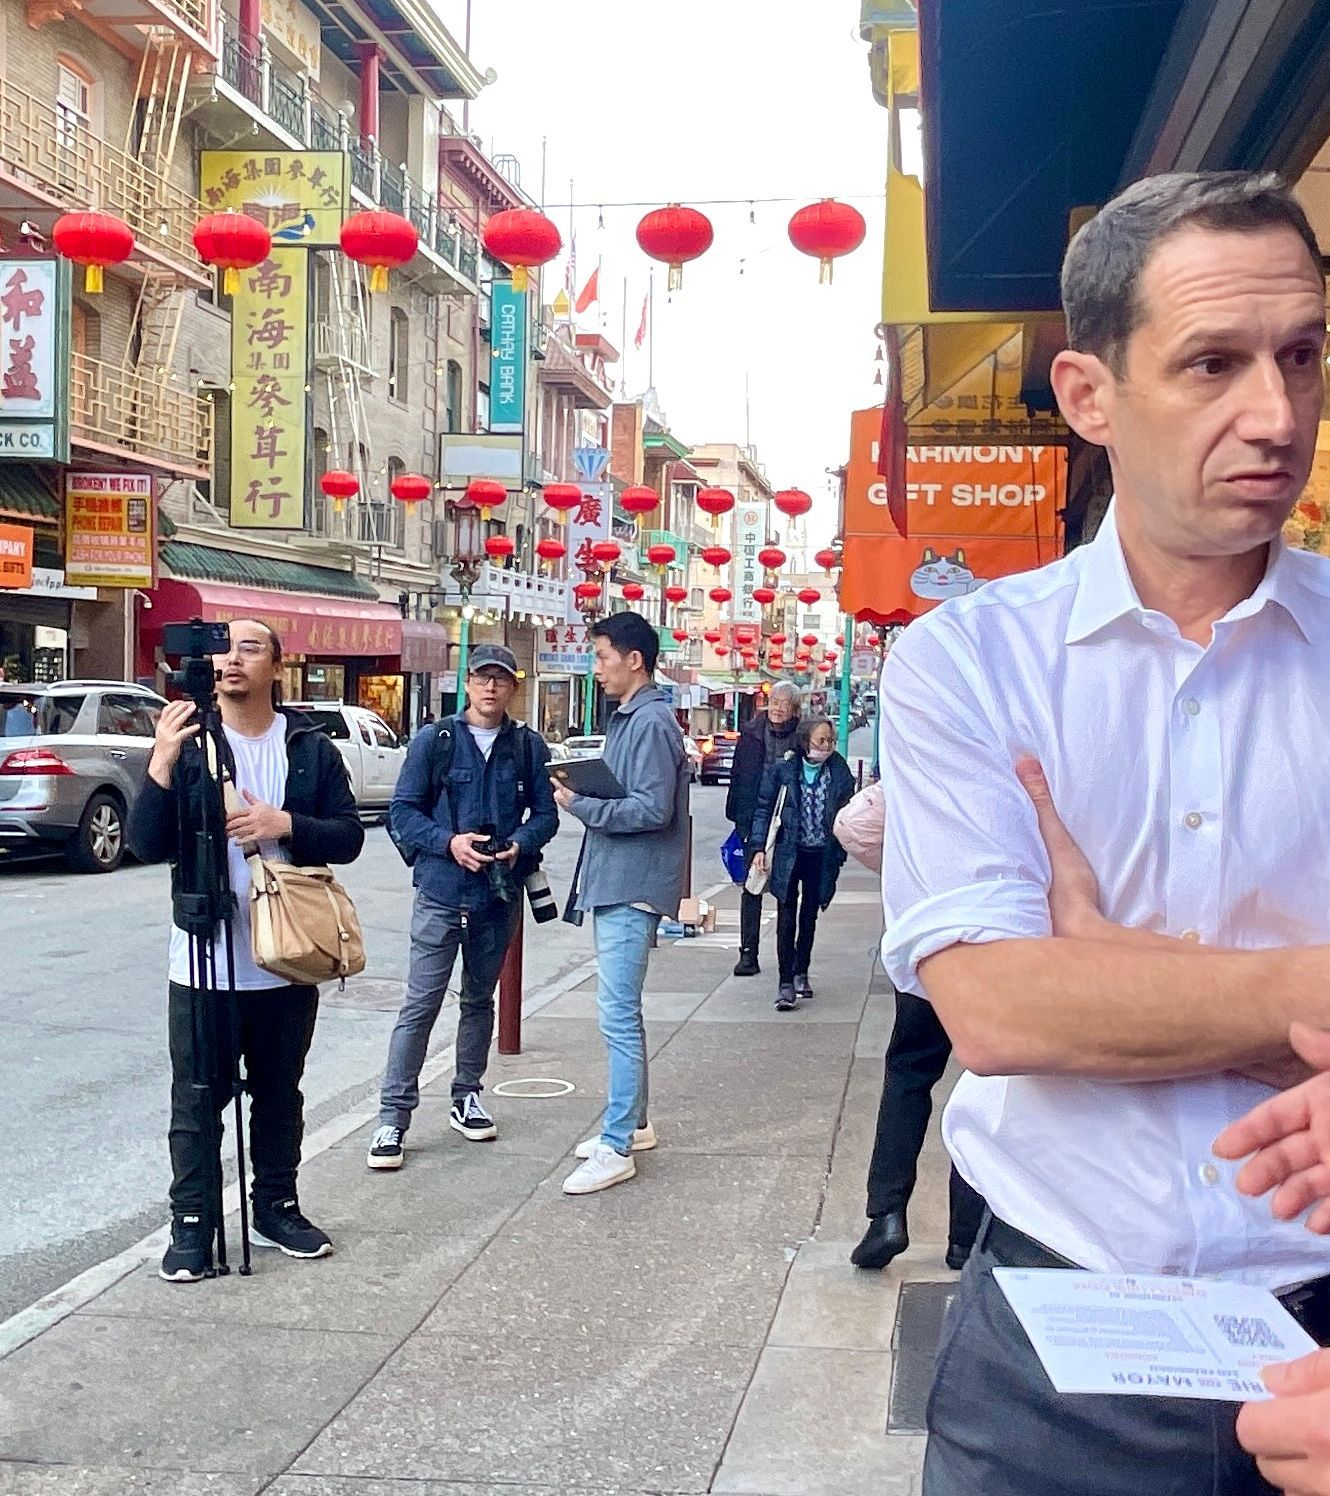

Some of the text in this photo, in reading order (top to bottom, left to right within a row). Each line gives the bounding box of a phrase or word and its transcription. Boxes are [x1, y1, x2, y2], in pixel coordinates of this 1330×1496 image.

[500, 304, 516, 404] CATHAY BANK
[0, 433, 43, 448] K CO.
[867, 484, 1046, 507] GFT SHOP
[1112, 1371, 1193, 1389] MAYOR
